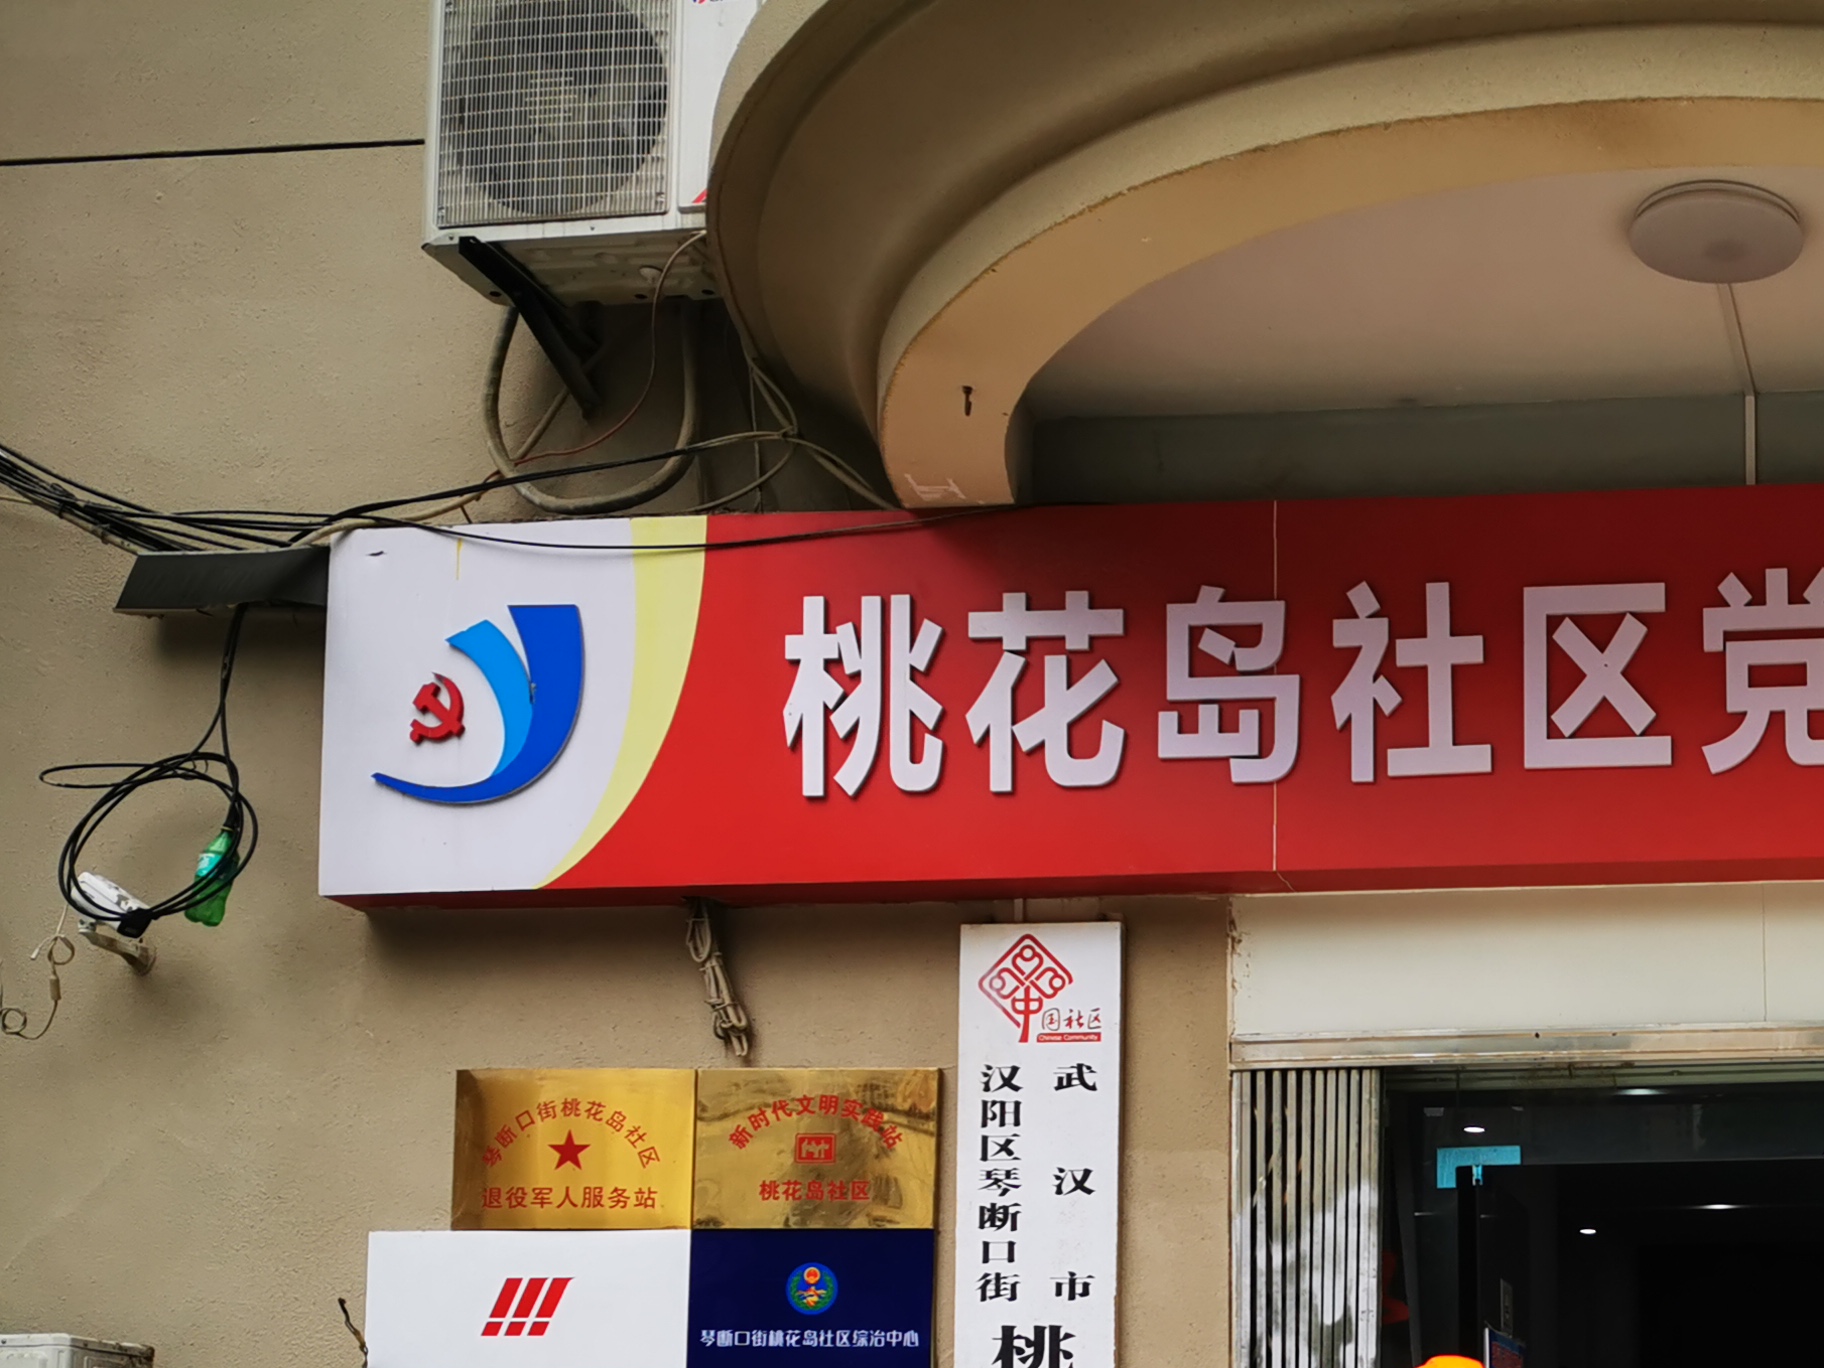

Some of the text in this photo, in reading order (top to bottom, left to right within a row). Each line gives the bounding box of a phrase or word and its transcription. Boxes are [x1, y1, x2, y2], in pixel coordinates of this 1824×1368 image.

[481, 1097, 662, 1169] 琴断口街桃花岛社区
[727, 1094, 905, 1151] 新时代文明实践站
[481, 1186, 660, 1210] 退役军人服务站
[758, 1179, 872, 1203] 桃花岛社区
[976, 1063, 1023, 1303] 汉阳区琴断口街
[1050, 1062, 1098, 1301] 武汉市
[700, 1329, 920, 1348] 琴断口街桃花岛社区综治中心
